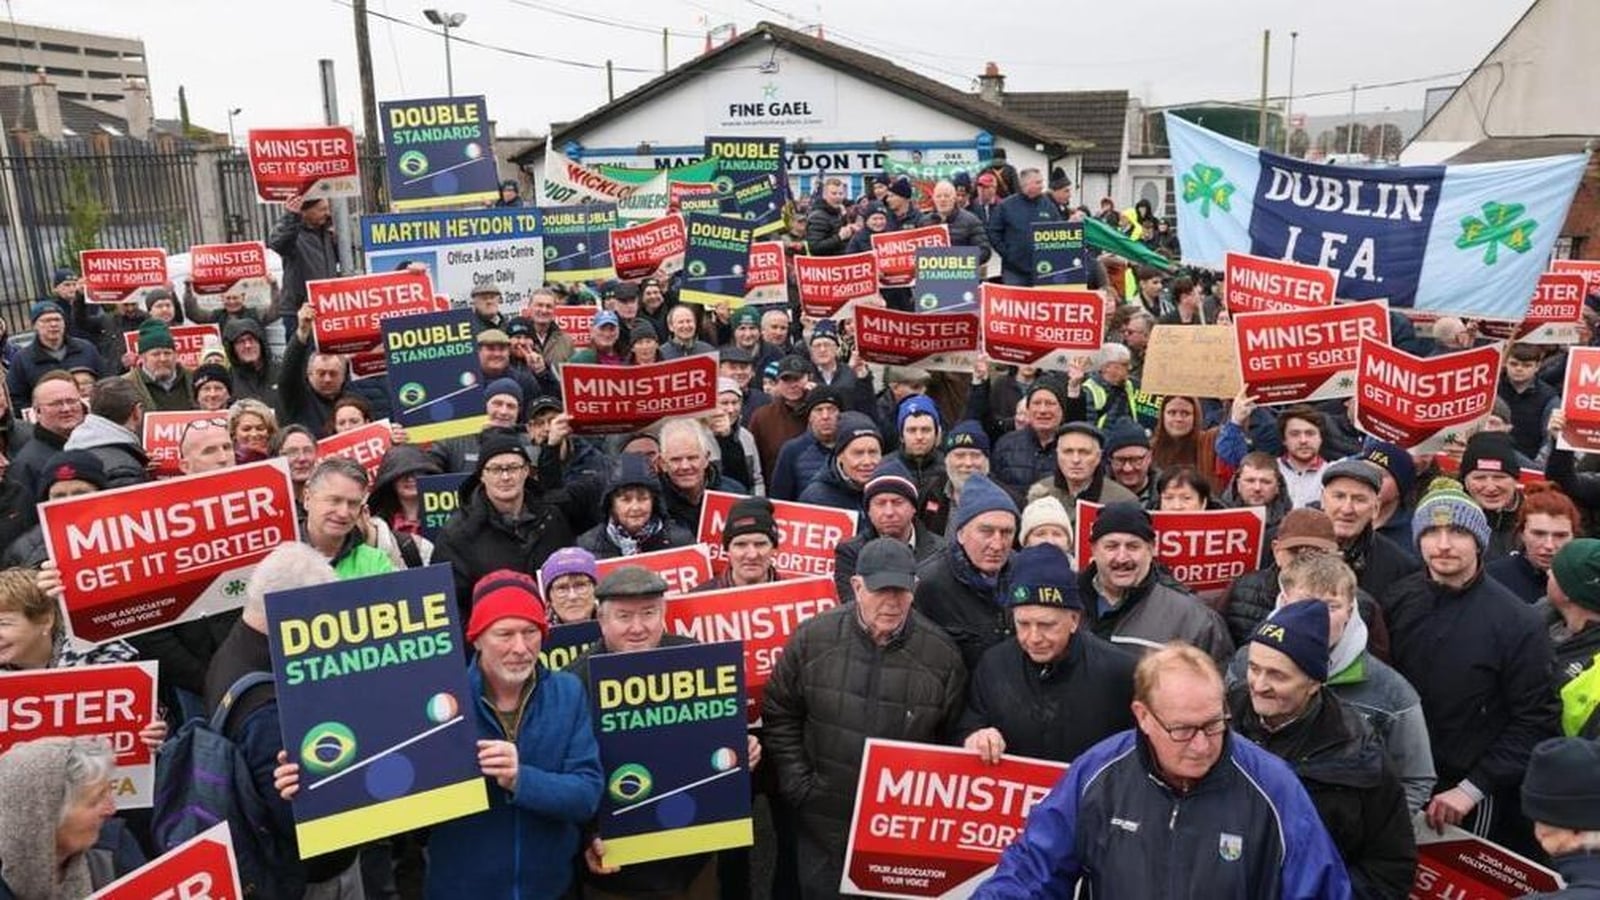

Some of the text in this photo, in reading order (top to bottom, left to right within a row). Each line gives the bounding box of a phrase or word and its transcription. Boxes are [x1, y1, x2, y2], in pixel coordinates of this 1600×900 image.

[390, 103, 480, 128] DOUBLE
[729, 102, 812, 117] FINE GAEL
[393, 125, 481, 144] STANDARDS
[711, 143, 779, 158] DOUBLE
[258, 159, 350, 174] GET IT SORTED
[858, 154, 888, 169] TD
[1265, 166, 1430, 221] DUBLIN
[371, 215, 536, 244] MARTIN HEYDON TD
[691, 222, 750, 242] DOUBLE
[1034, 229, 1083, 242] DOUBLE
[447, 252, 472, 265] Office
[483, 247, 509, 260] Advice
[510, 246, 534, 258] Centre
[918, 255, 976, 270] DOUBLE
[1229, 290, 1250, 306] GET
[1252, 296, 1264, 310] IT
[990, 299, 1098, 324] MINISTER,
[322, 315, 354, 333] GET
[356, 313, 367, 328] IT
[990, 321, 1093, 342] GET IT SORTED
[387, 322, 473, 350] DOUBLE
[863, 332, 969, 350] GET IT SORTED
[1246, 317, 1383, 351] MINISTER,
[390, 342, 474, 365] STANDARDS
[1249, 355, 1282, 371] GET
[1287, 353, 1303, 368] IT
[575, 392, 706, 414] GET IT SORTED
[1363, 383, 1487, 419] GET IT SORTED
[1369, 449, 1389, 466] IFA
[65, 486, 285, 560] MINISTER,
[75, 526, 282, 592] GET IT SORTED
[1038, 587, 1063, 603] IFA
[280, 593, 450, 657] DOUBLE
[1257, 623, 1285, 642] IFA
[285, 631, 453, 685] STANDARDS
[599, 664, 738, 709] DOUBLE
[601, 698, 738, 733] STANDARDS
[869, 814, 925, 839] GET
[929, 819, 956, 843] IT
